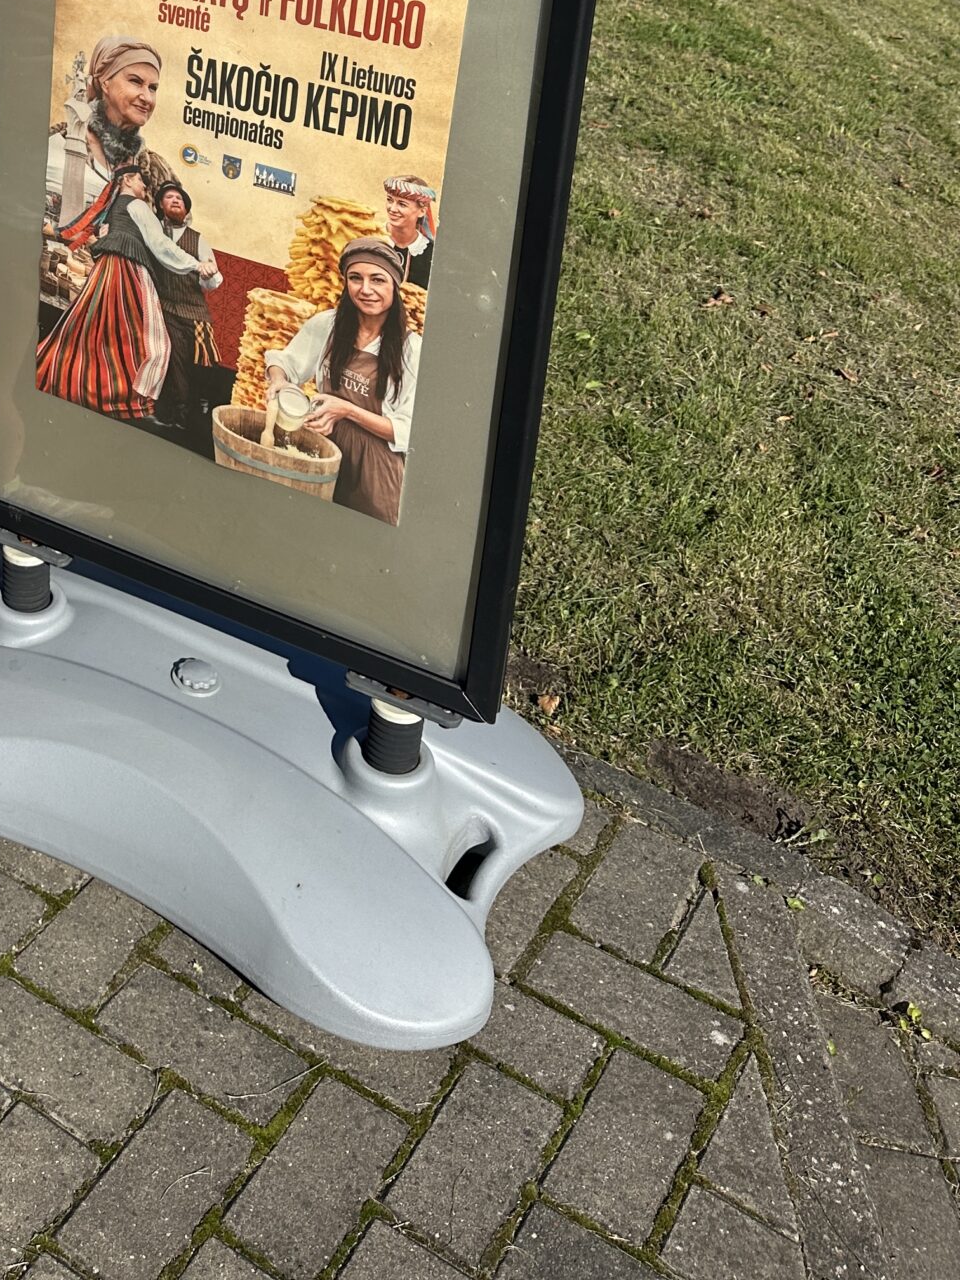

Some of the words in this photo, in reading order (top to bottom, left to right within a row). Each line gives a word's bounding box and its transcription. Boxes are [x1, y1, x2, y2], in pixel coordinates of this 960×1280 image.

[185, 46, 299, 123] ŠAKOČIO
[303, 81, 413, 151] KEPIMO
[320, 50, 339, 83] IX
[340, 55, 417, 101] Lietuvos
[183, 99, 284, 150] čempionatas
